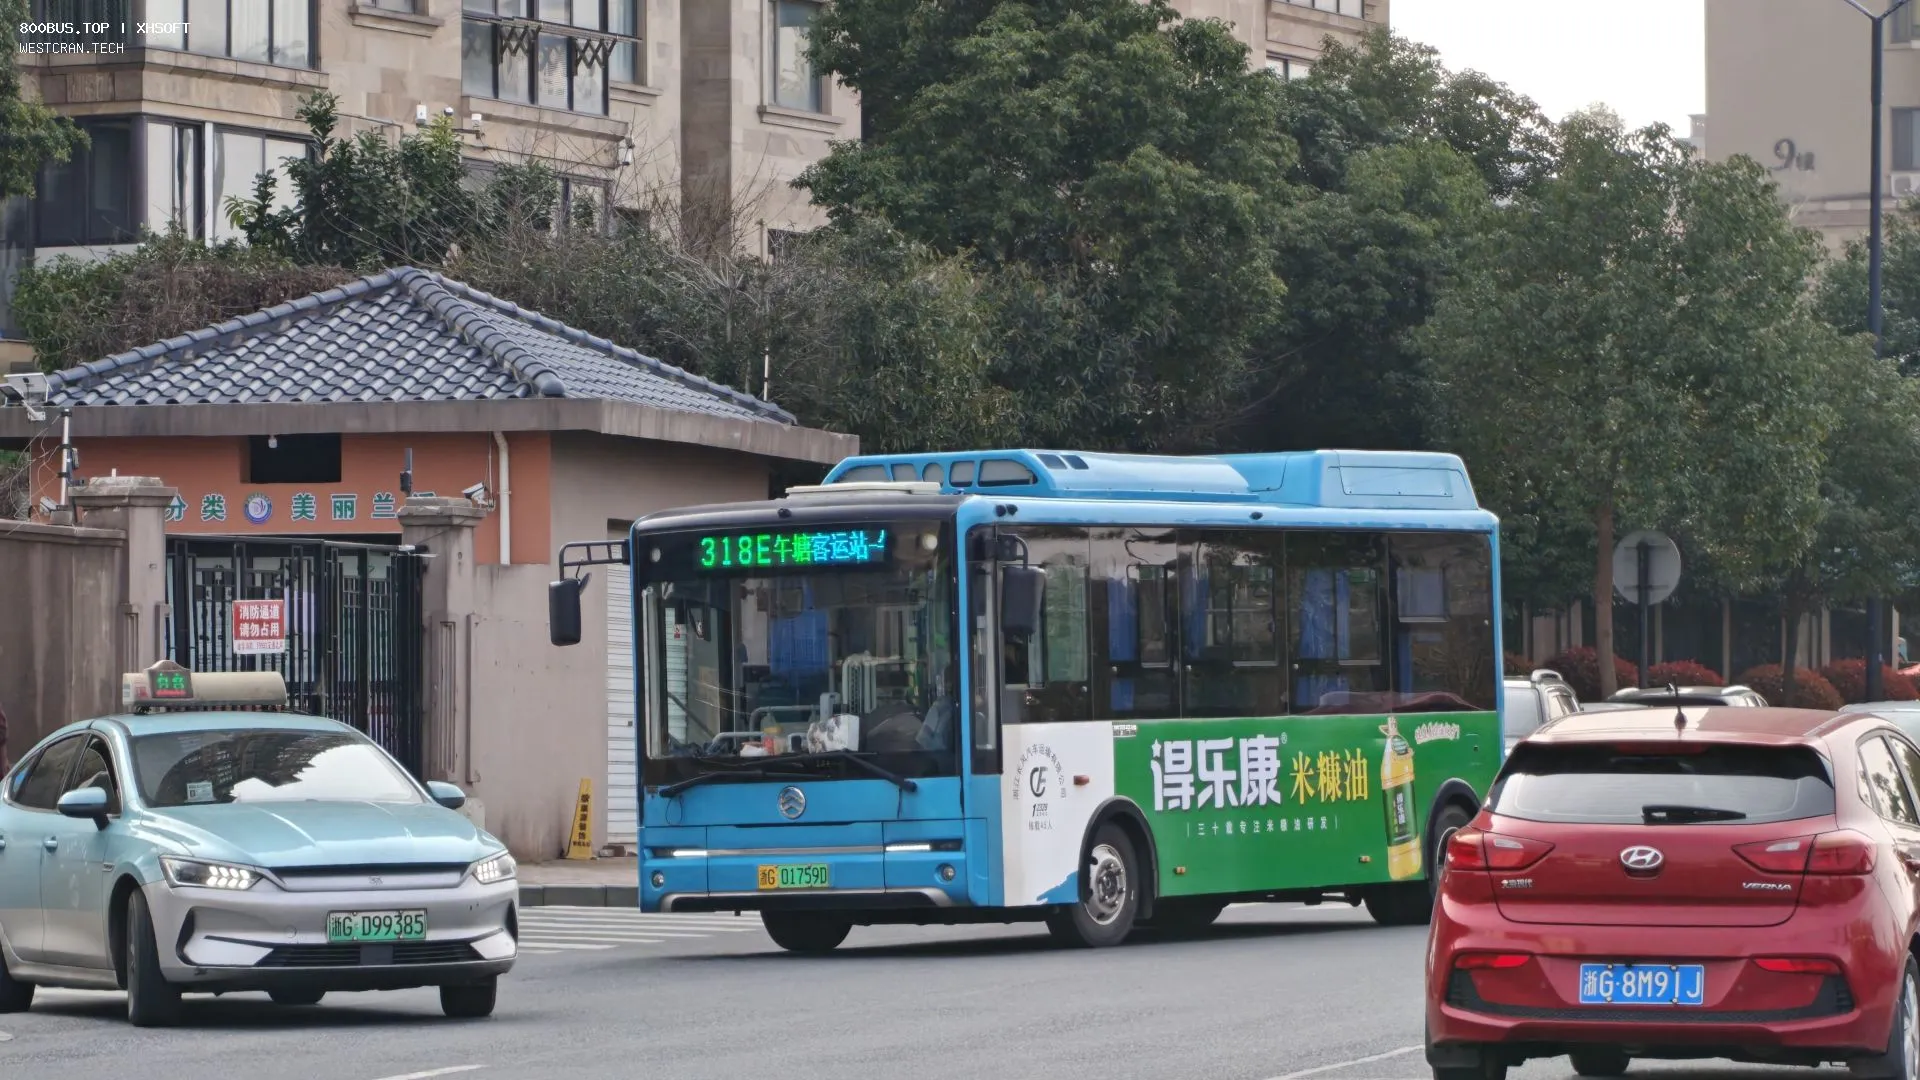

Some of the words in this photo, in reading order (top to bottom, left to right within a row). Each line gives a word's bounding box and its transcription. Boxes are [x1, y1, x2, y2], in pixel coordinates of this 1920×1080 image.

[291, 491, 436, 521] 美丽兰
[239, 603, 280, 620] 消防通道
[239, 622, 280, 638] 请勿占用
[1150, 733, 1282, 812] 得乐康
[1289, 747, 1369, 805] 米糠油
[1742, 882, 1792, 890] VERNA
